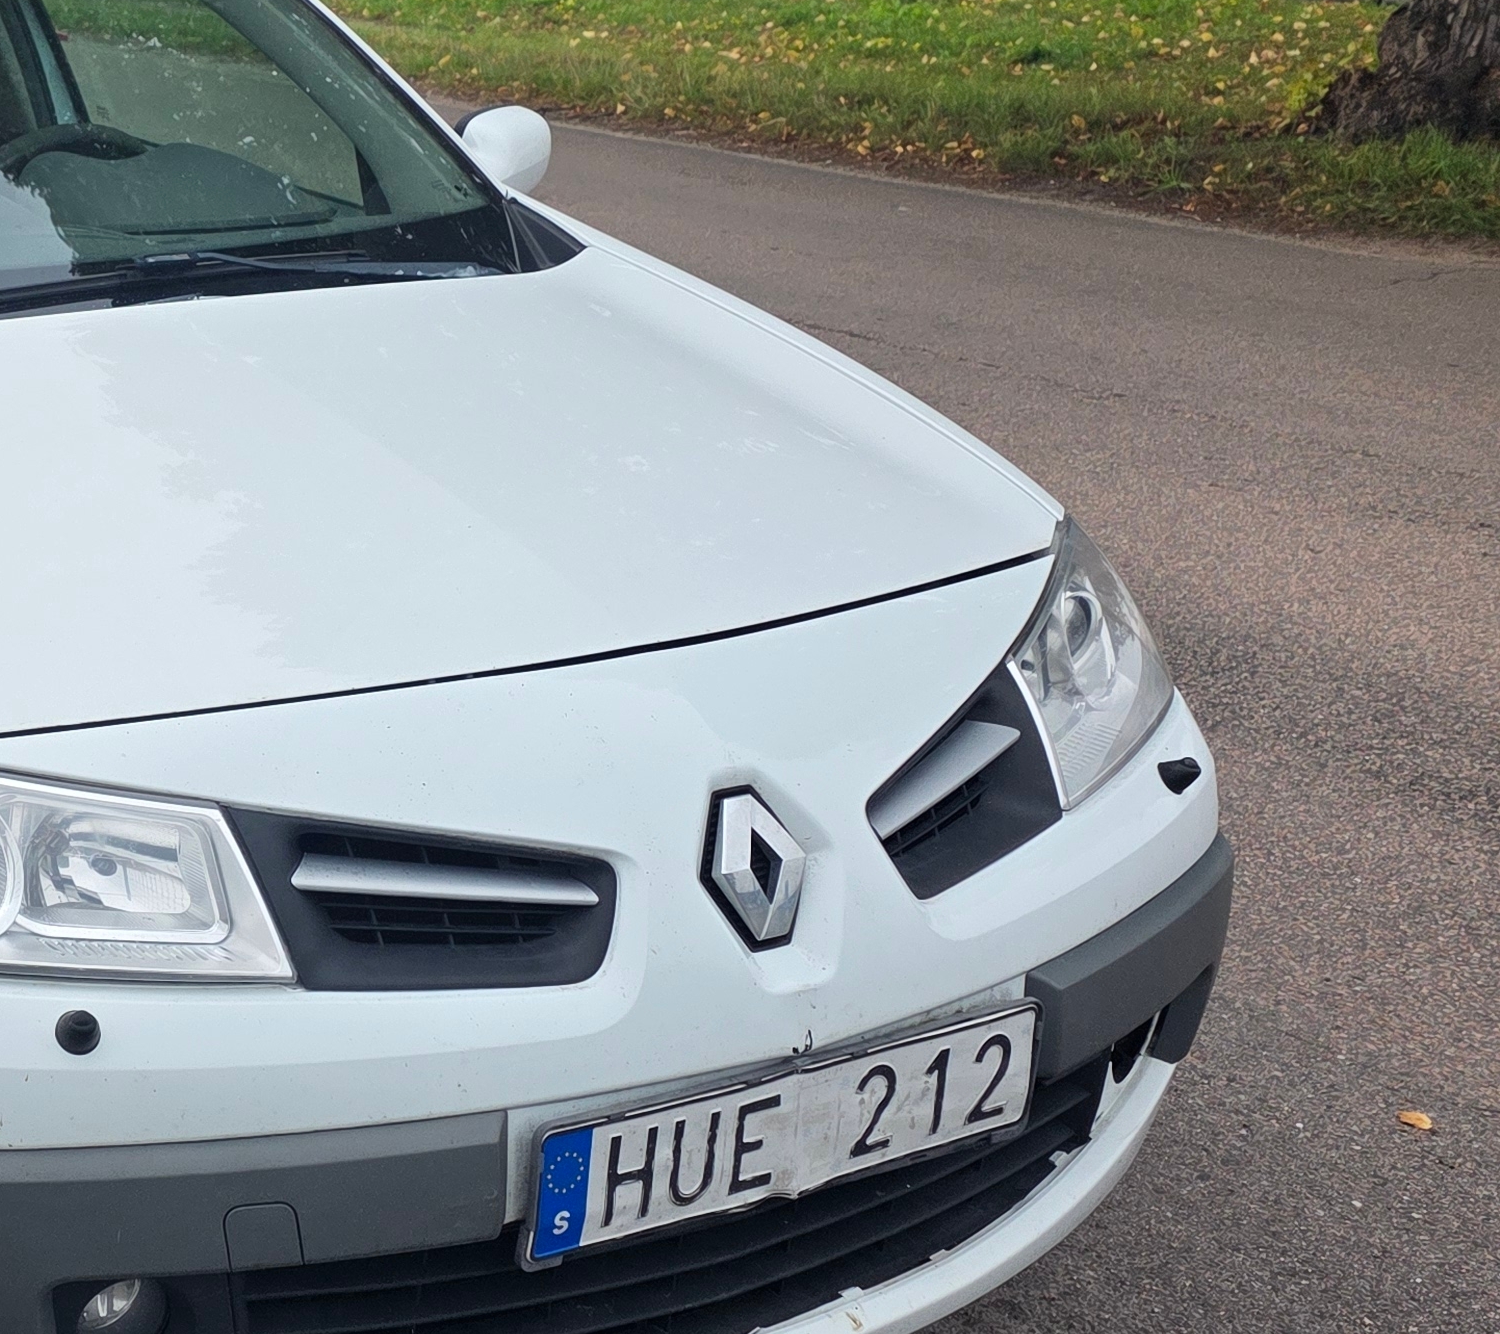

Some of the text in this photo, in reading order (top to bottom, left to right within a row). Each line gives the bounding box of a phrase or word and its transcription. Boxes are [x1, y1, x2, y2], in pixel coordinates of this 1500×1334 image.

[600, 1033, 1011, 1229] HUE 212
[552, 1210, 571, 1235] S
